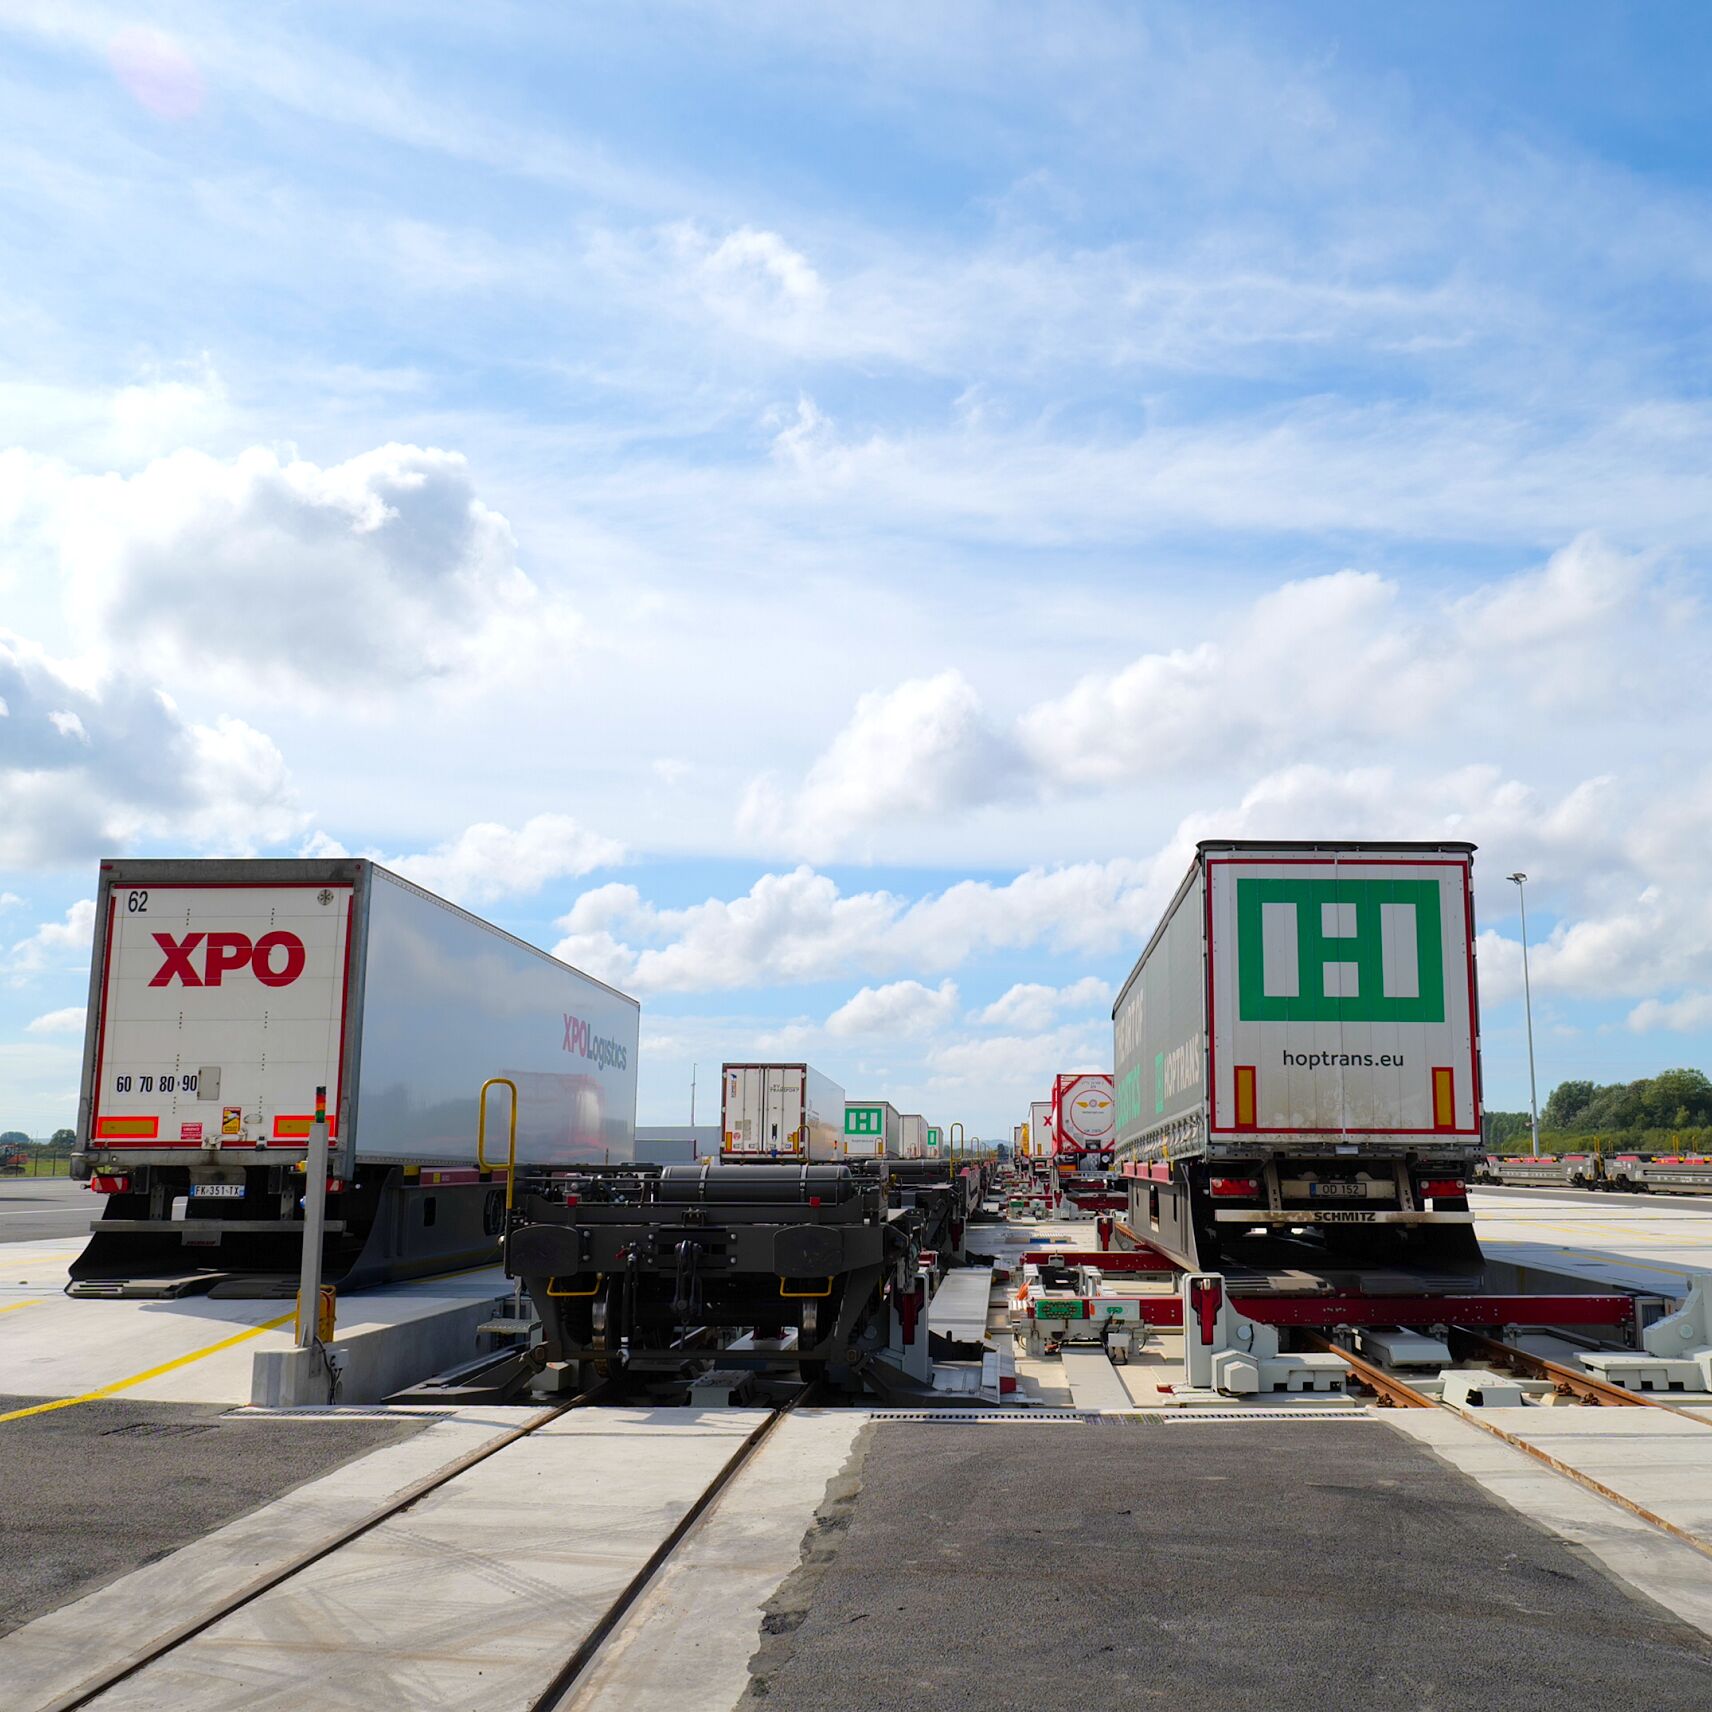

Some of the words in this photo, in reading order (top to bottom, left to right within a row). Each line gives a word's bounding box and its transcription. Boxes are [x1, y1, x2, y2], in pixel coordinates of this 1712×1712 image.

[128, 890, 148, 912] 62
[147, 931, 306, 987] XPO
[1164, 1032, 1200, 1101] HOPTRANS
[1283, 1050, 1404, 1070] hoptrans.eu
[116, 1075, 132, 1093] 60
[139, 1075, 154, 1093] 70
[159, 1075, 175, 1093] 80
[182, 1074, 198, 1092] 90
[1322, 1184, 1337, 1195] OD
[1341, 1184, 1360, 1195] 152
[1314, 1211, 1376, 1222] SCHMITZ
